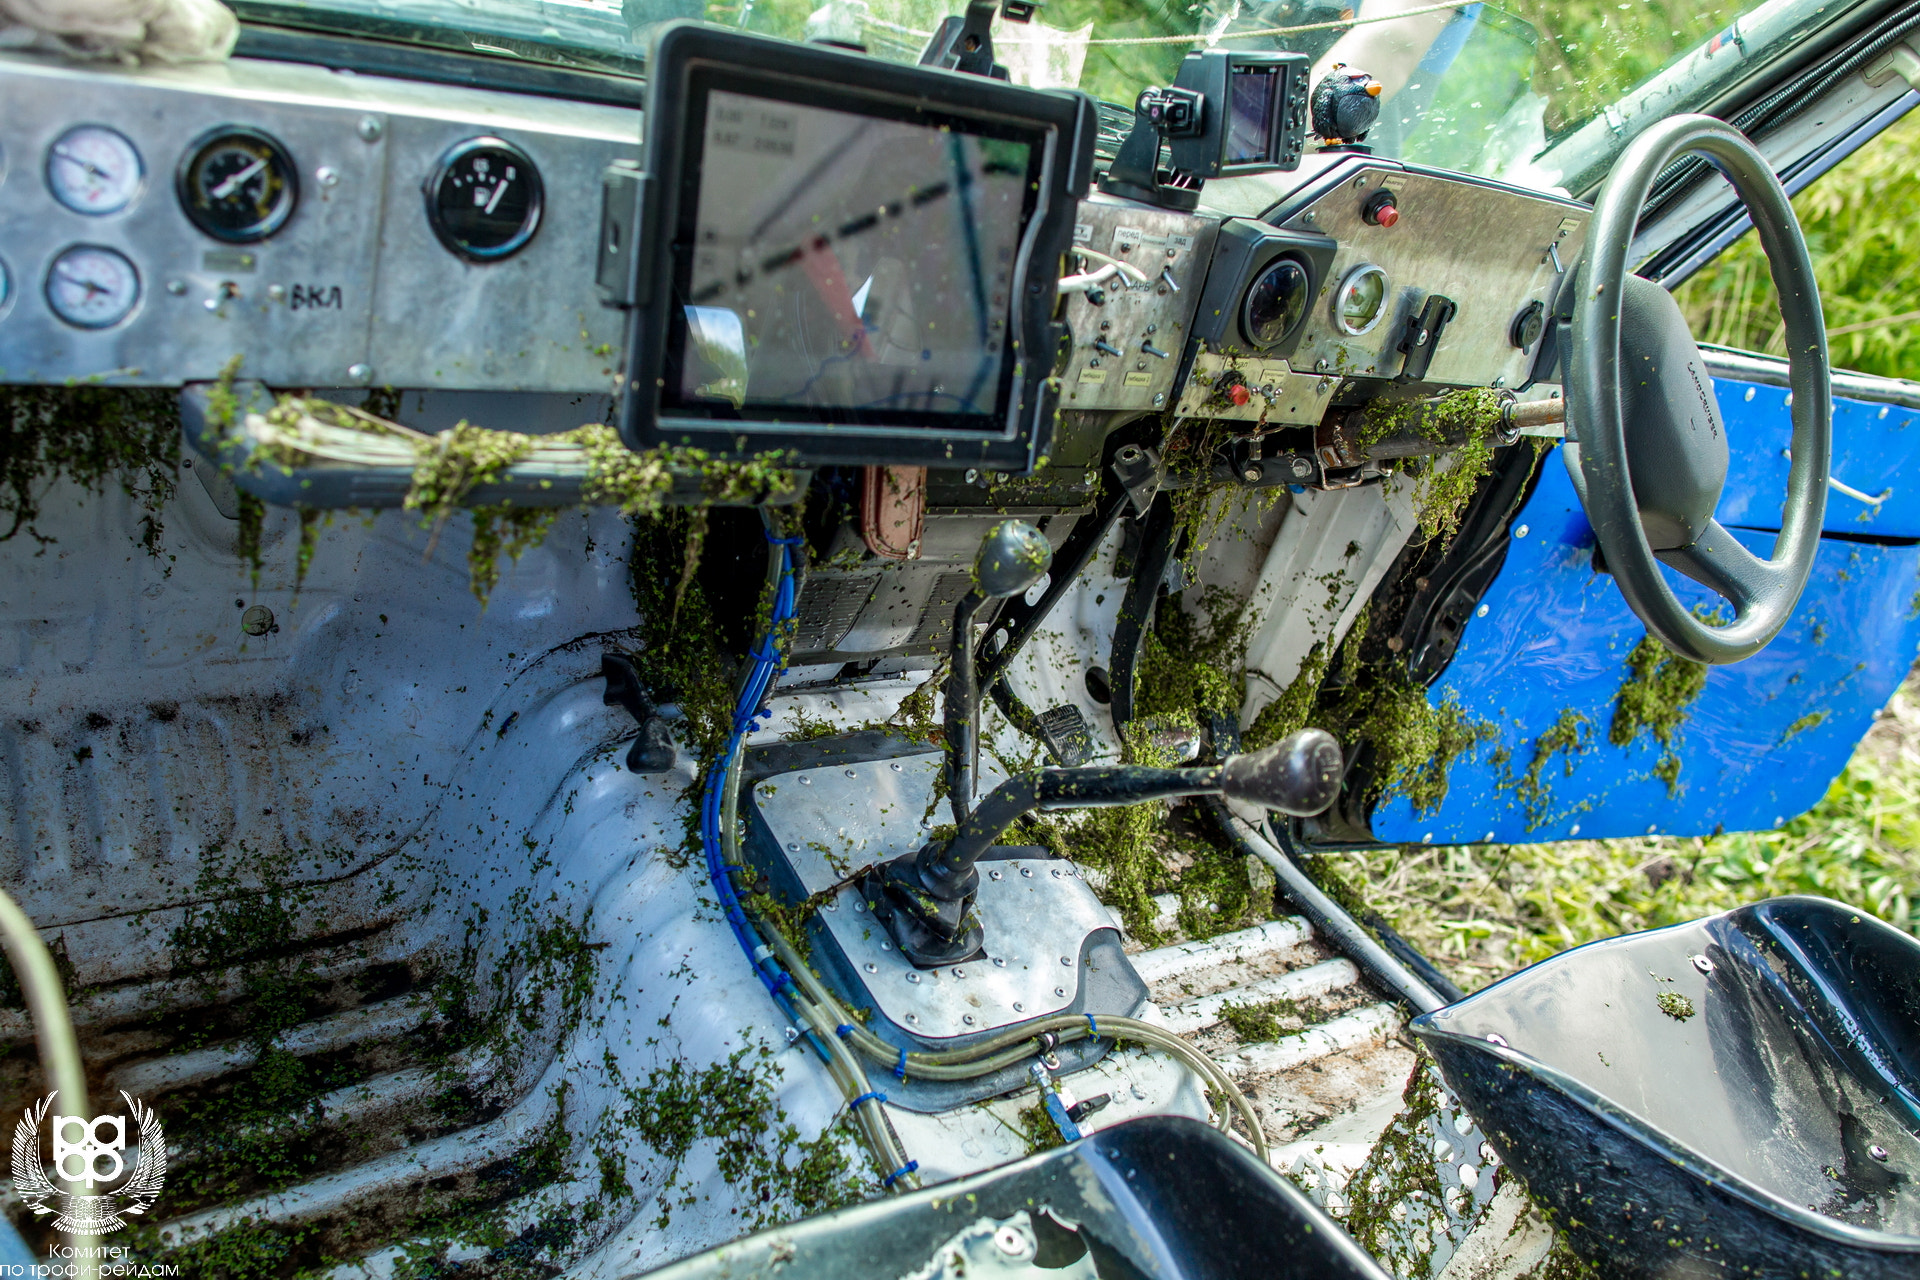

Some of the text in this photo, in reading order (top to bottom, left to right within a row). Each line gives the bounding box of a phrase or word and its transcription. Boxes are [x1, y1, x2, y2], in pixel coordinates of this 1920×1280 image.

[1117, 229, 1140, 240] перед
[1174, 236, 1187, 247] зад
[291, 283, 342, 312] ВКЛ
